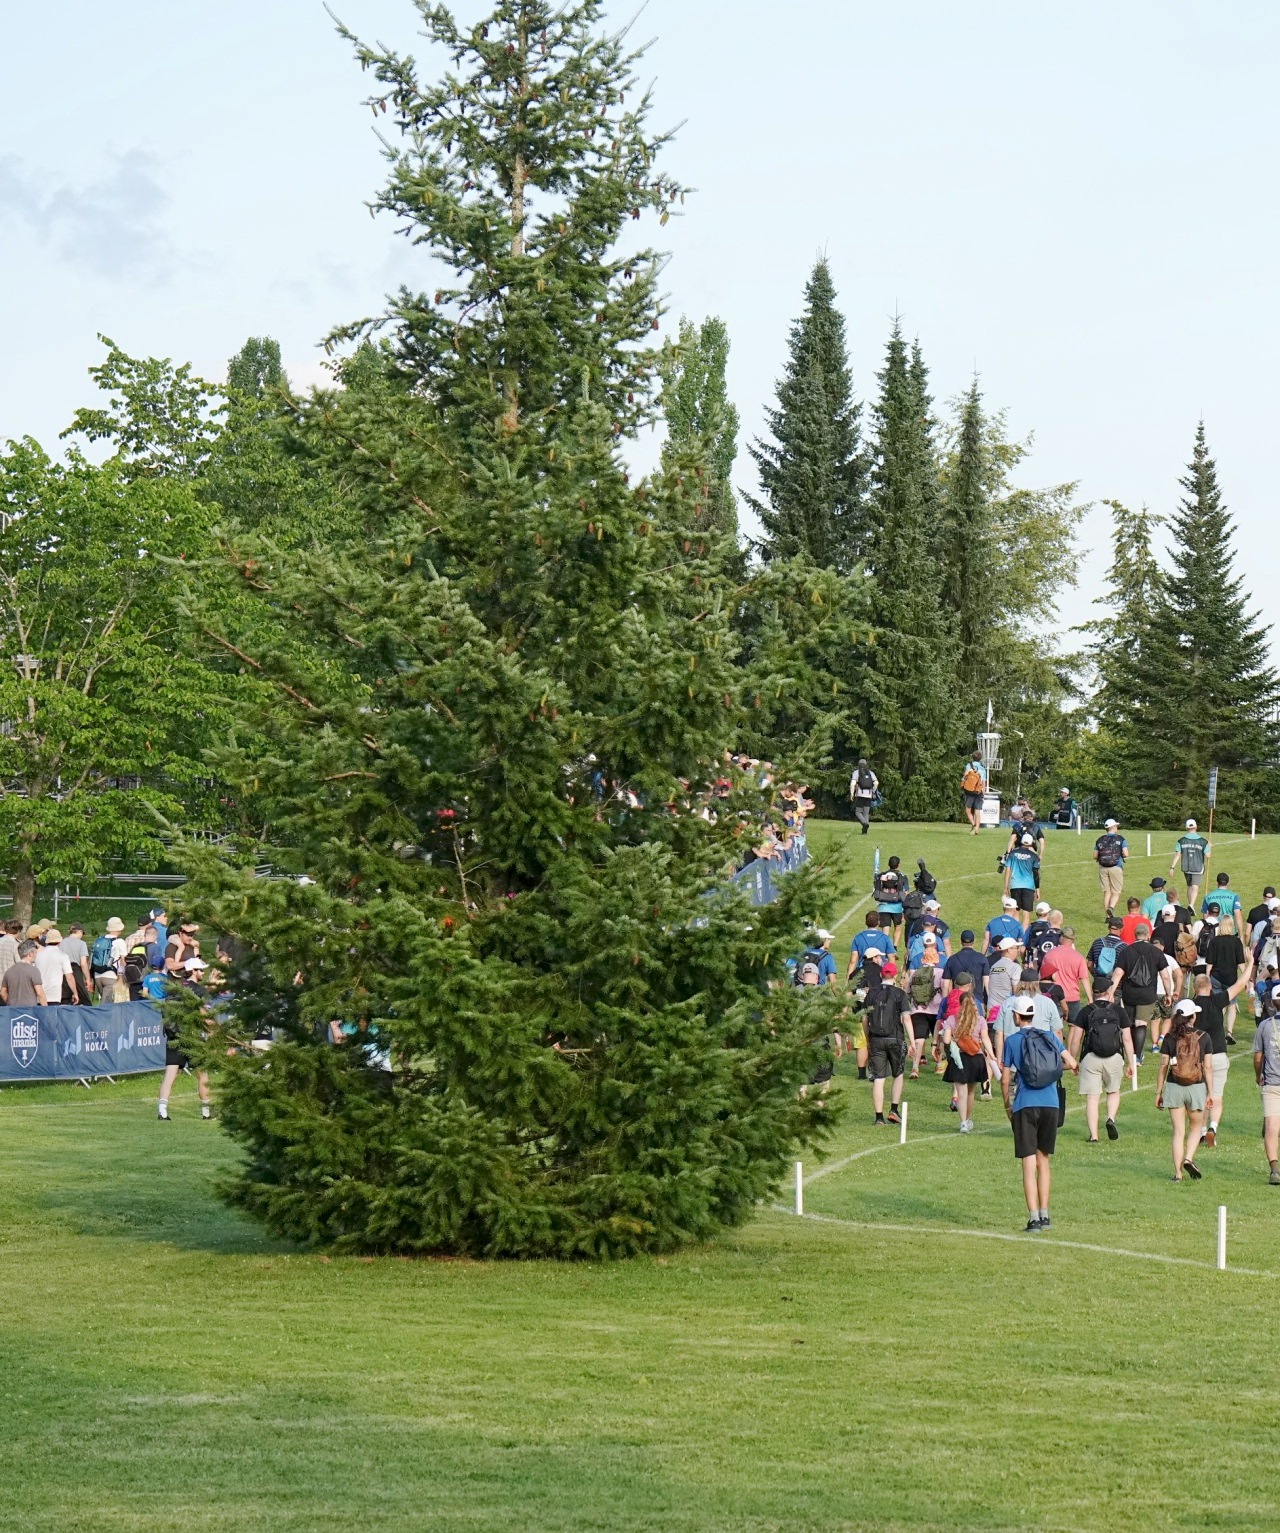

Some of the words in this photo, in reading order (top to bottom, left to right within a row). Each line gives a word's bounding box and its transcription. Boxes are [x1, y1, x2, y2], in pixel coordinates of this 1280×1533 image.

[13, 1022, 37, 1039] disc
[137, 1026, 151, 1035] CITY
[153, 1025, 160, 1033] OF
[13, 1039, 36, 1047] mania
[137, 1036, 161, 1047] NOKIA
